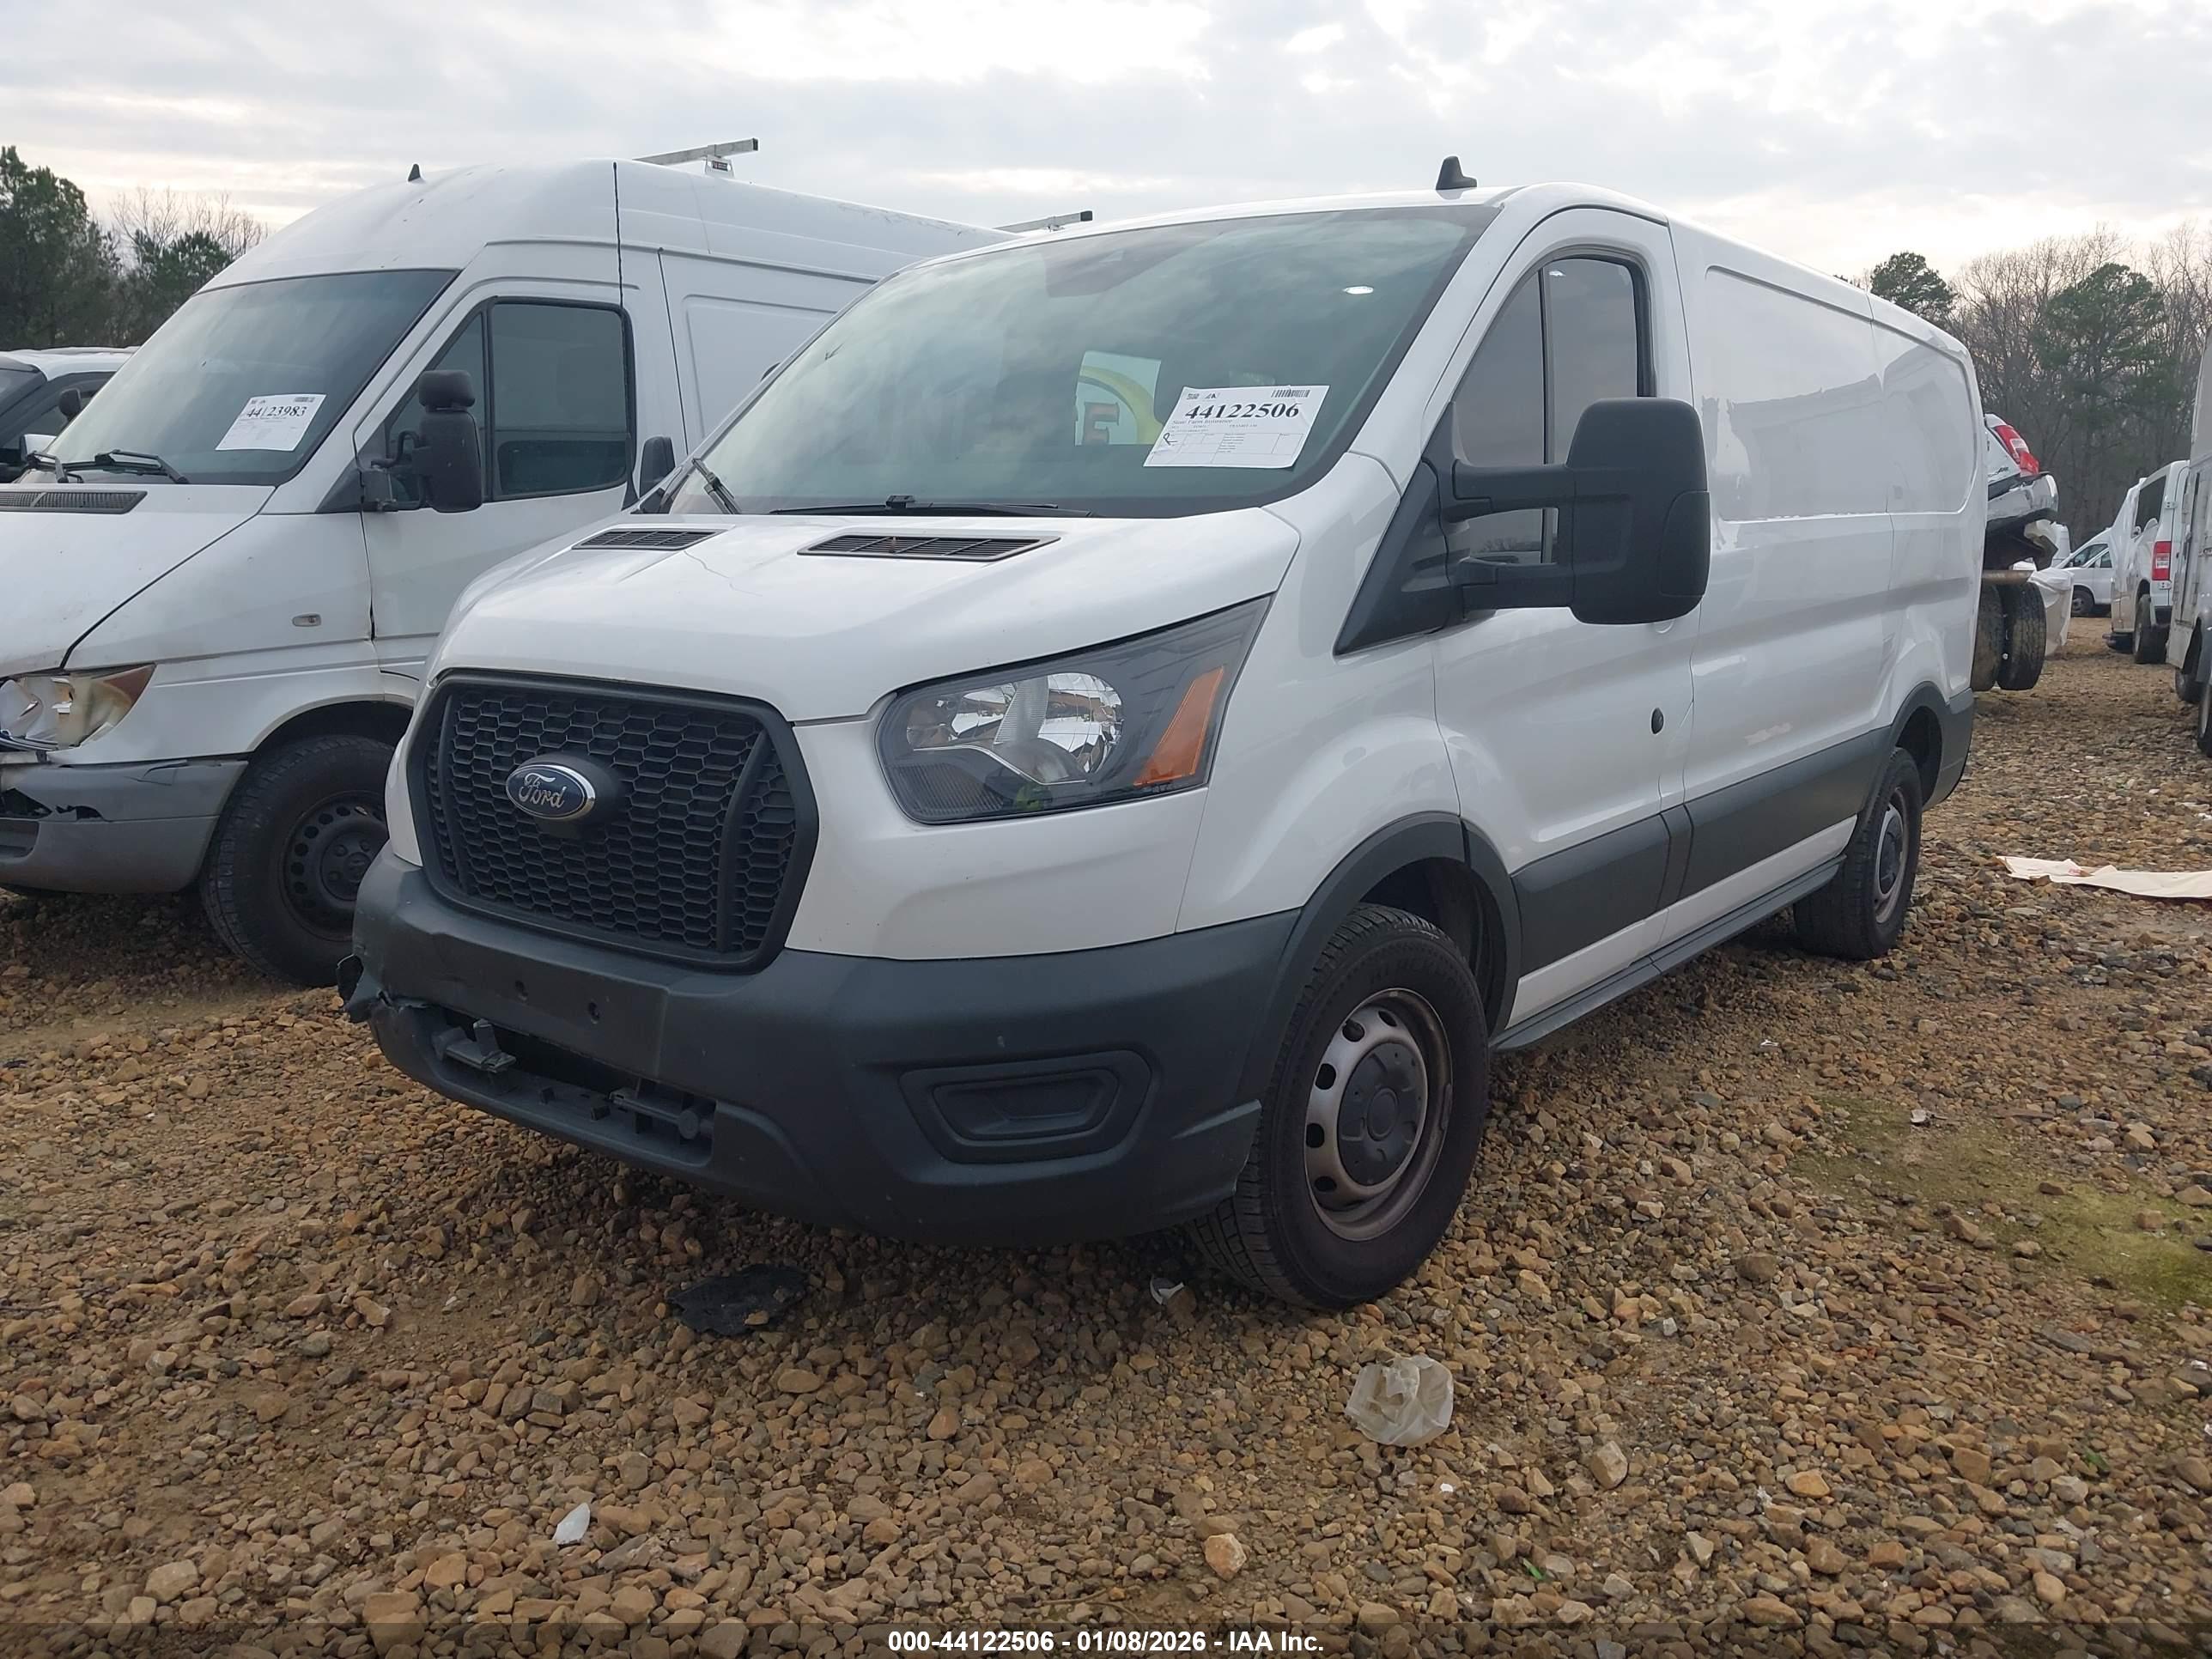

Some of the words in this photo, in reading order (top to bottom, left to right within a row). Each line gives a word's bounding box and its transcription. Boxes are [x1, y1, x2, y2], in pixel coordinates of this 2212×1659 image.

[246, 405, 307, 417] 44123983
[1185, 403, 1299, 419] 44122506
[518, 772, 568, 809] Ford
